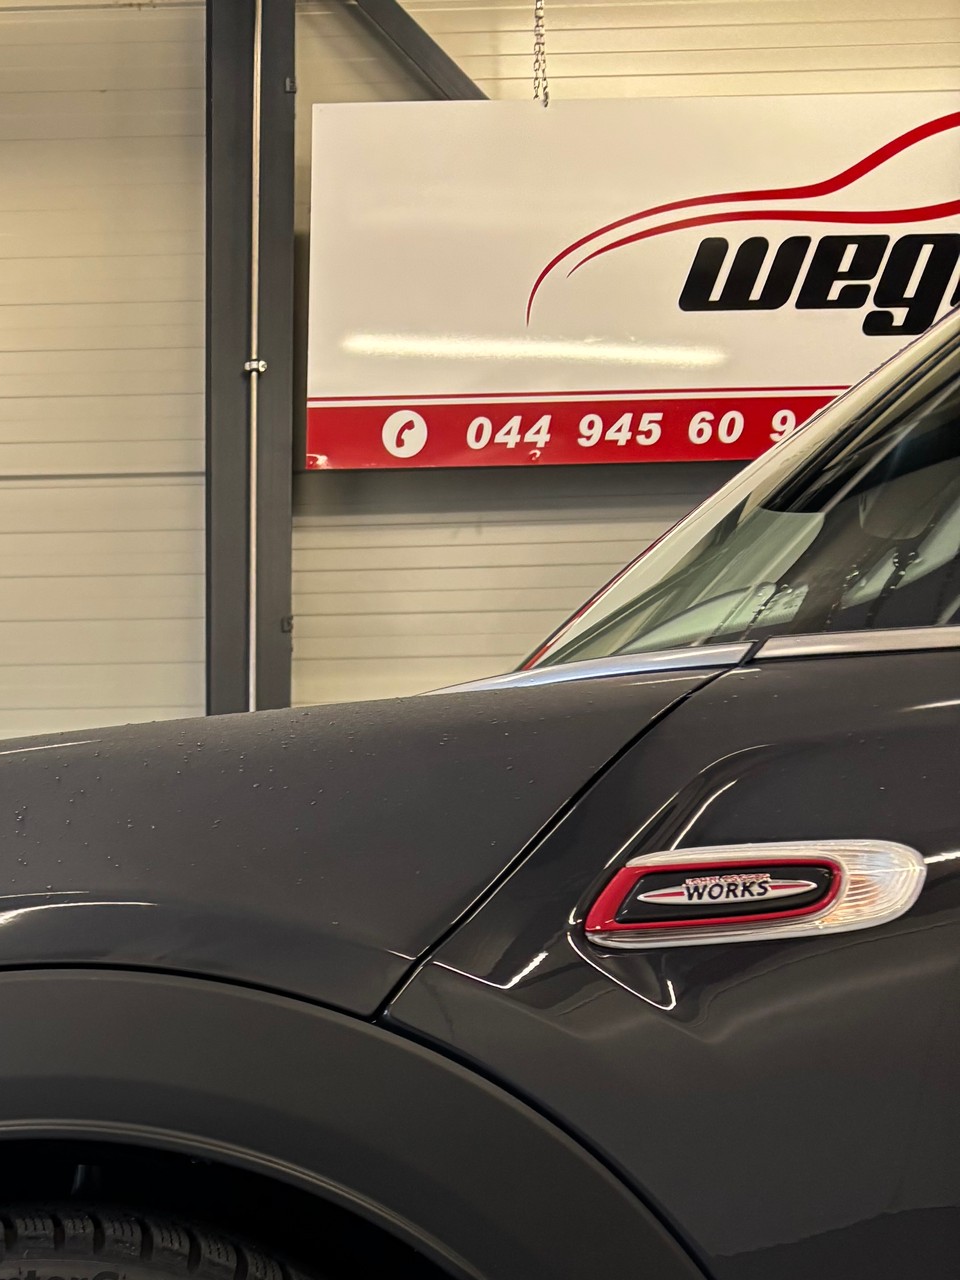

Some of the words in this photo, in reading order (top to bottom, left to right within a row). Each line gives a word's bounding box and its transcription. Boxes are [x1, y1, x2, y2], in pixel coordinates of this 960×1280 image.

[678, 233, 960, 336] weg
[466, 414, 552, 450] 044
[577, 412, 663, 448] 945
[688, 410, 744, 445] 60
[685, 880, 770, 901] WORKS
